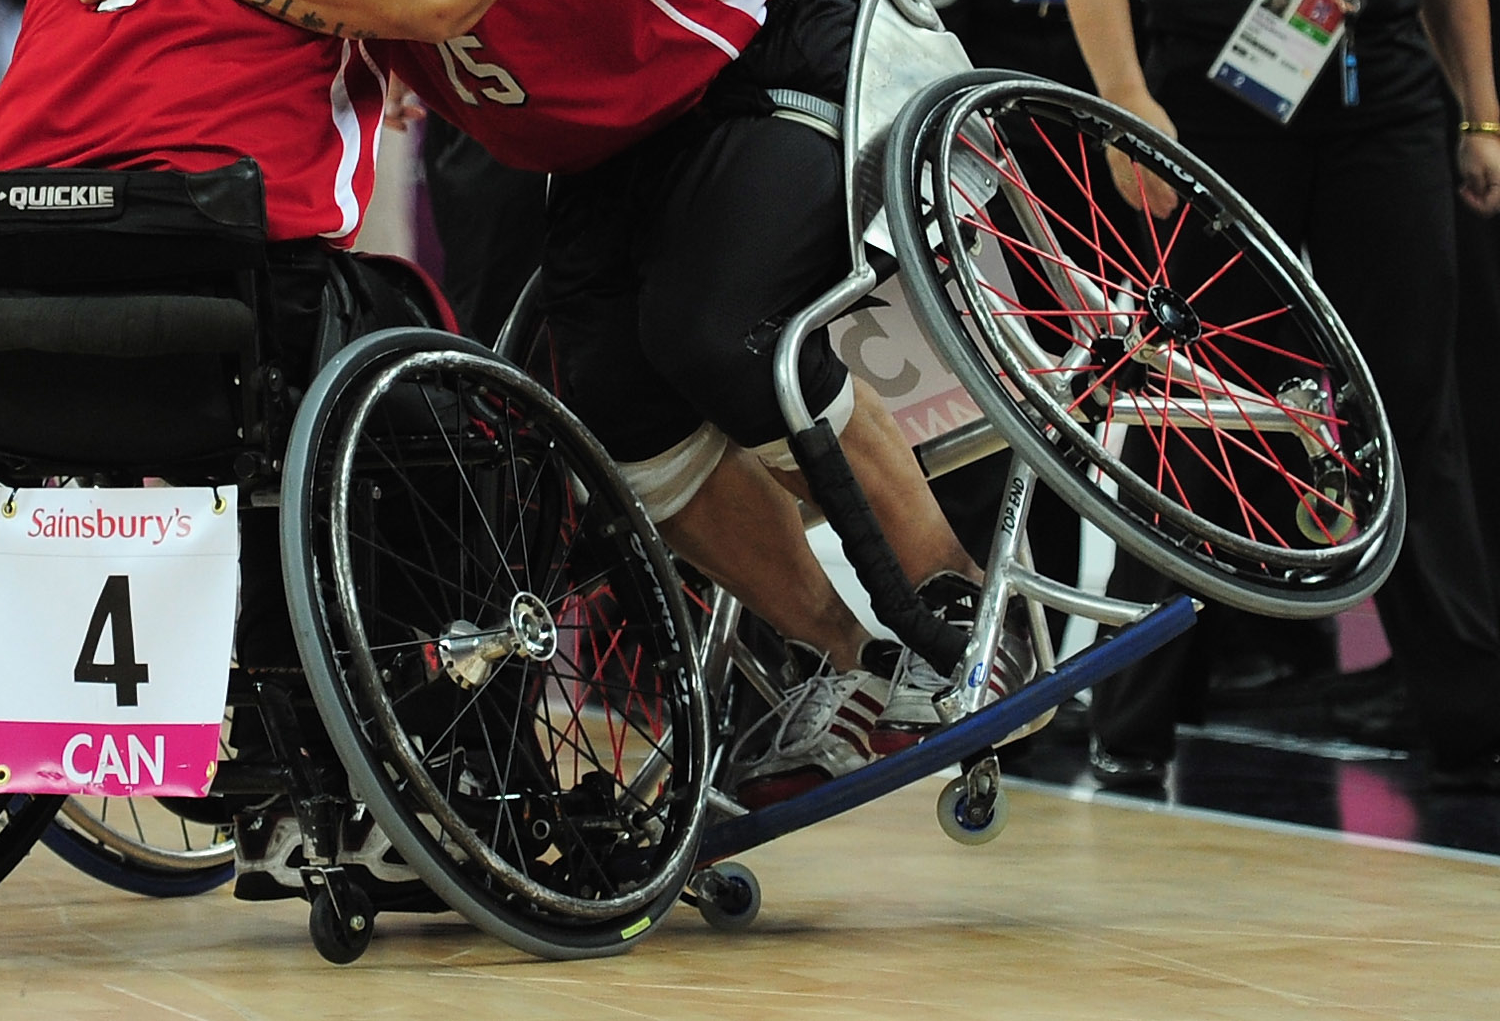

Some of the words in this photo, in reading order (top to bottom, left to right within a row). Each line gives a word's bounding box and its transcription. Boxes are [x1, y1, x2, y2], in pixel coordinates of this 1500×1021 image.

[9, 186, 114, 210] QUICKIE
[27, 508, 192, 545] Sainsbury's
[1001, 507, 1016, 536] TOP
[1009, 477, 1025, 508] END
[74, 575, 149, 707] 4
[62, 733, 164, 786] CAN
